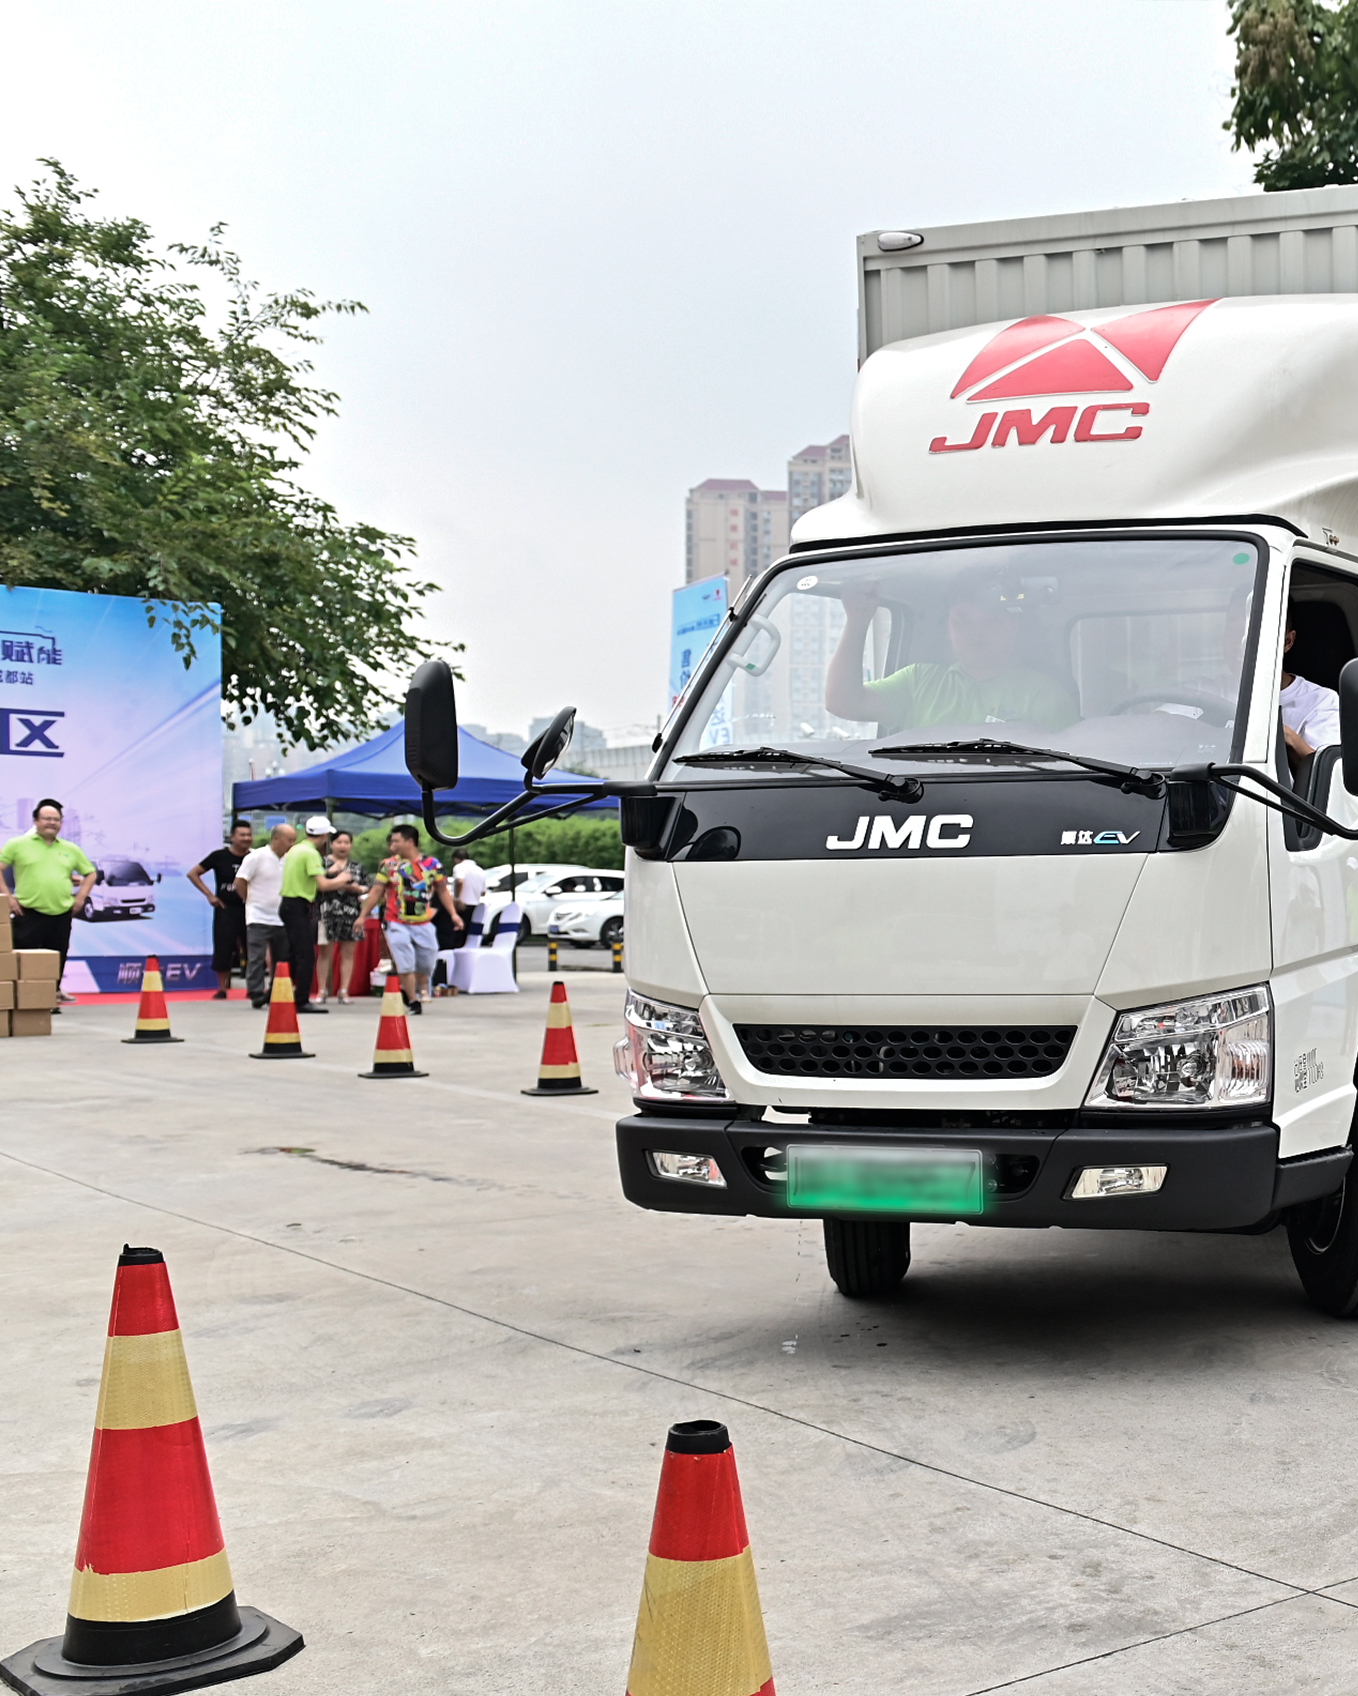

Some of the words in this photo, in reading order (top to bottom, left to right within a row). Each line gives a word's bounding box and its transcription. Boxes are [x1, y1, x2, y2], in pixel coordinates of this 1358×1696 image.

[929, 402, 1150, 453] JMC
[0, 670, 34, 685] 都站
[826, 814, 973, 850] JMC
